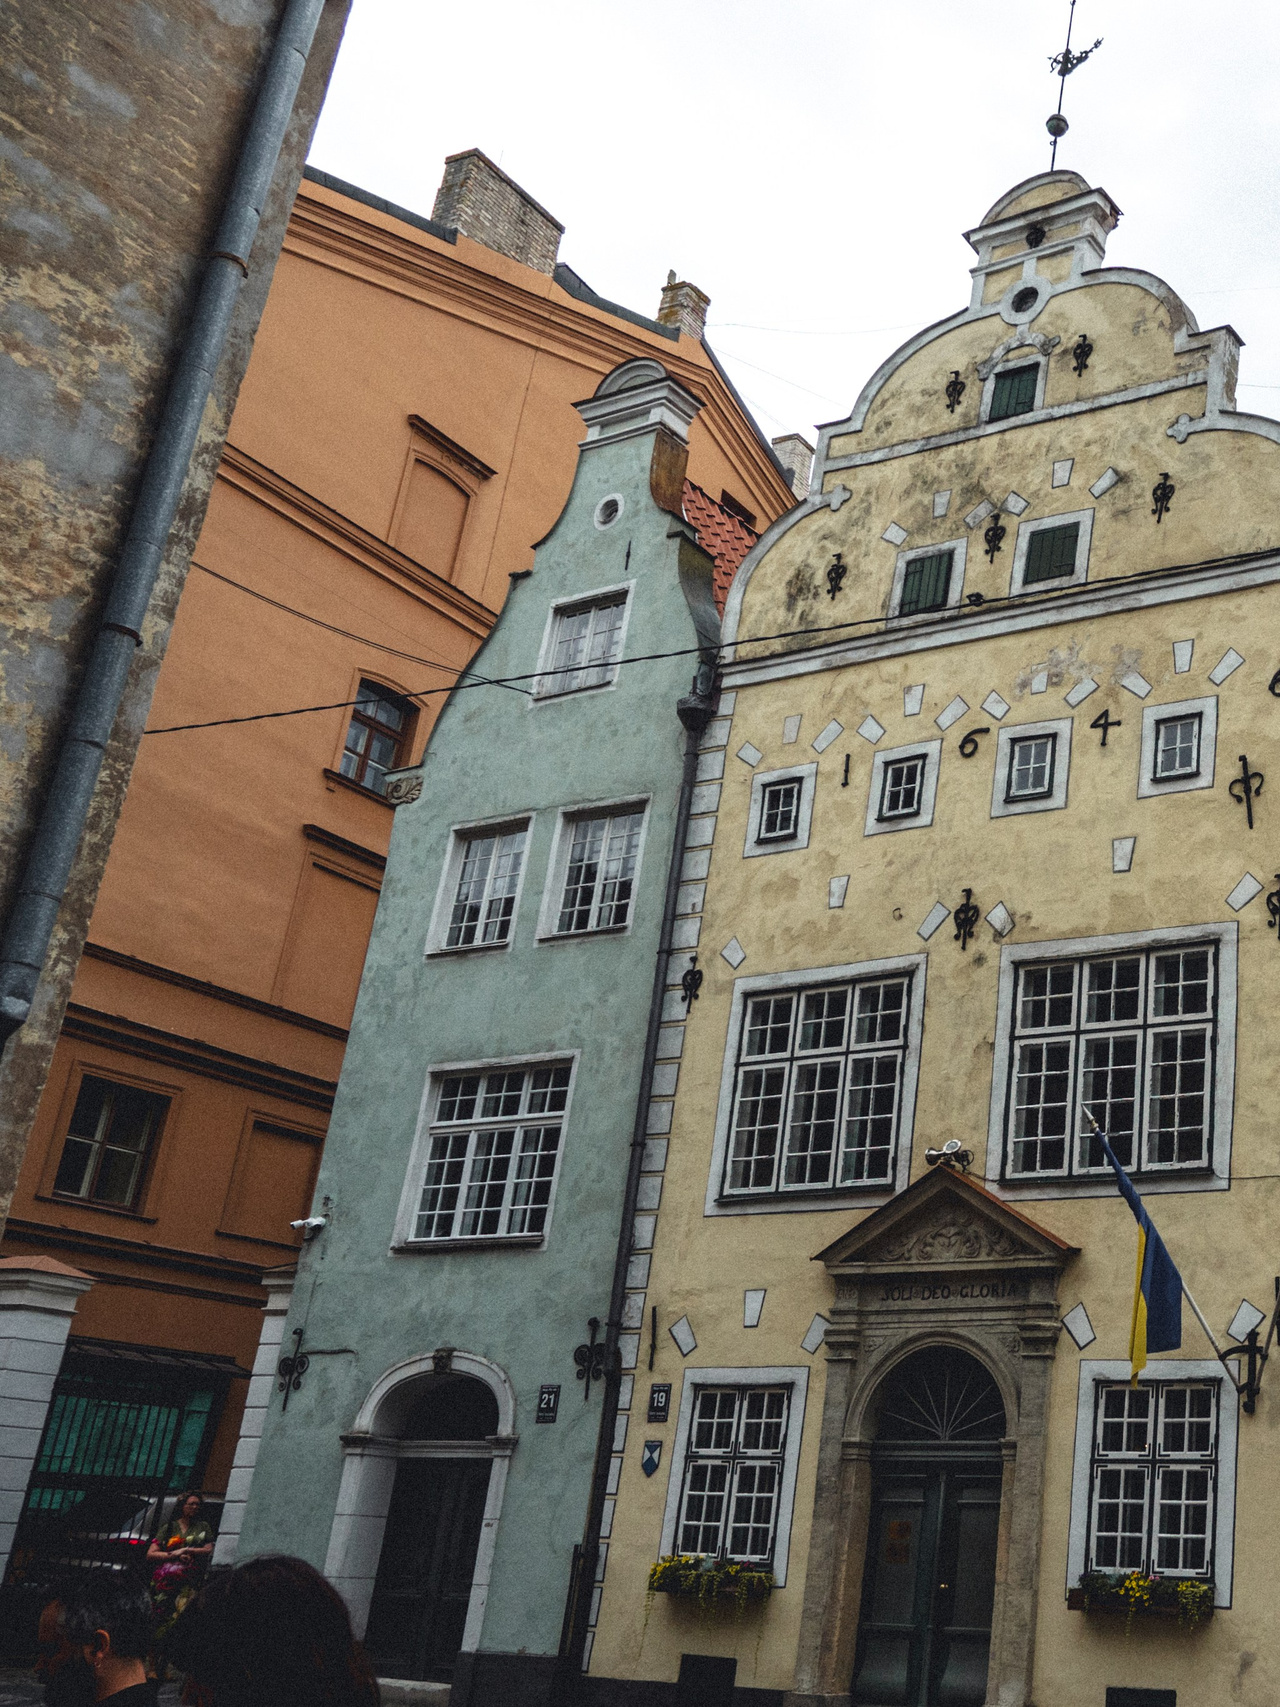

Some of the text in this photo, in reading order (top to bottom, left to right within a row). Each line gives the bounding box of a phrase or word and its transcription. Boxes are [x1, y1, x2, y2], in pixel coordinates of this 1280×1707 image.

[958, 726, 991, 758] 6
[1089, 709, 1122, 747] 4
[881, 1279, 1017, 1301] SOLI DEO GLORIA
[540, 1393, 556, 1408] 21
[653, 1391, 667, 1407] 19
